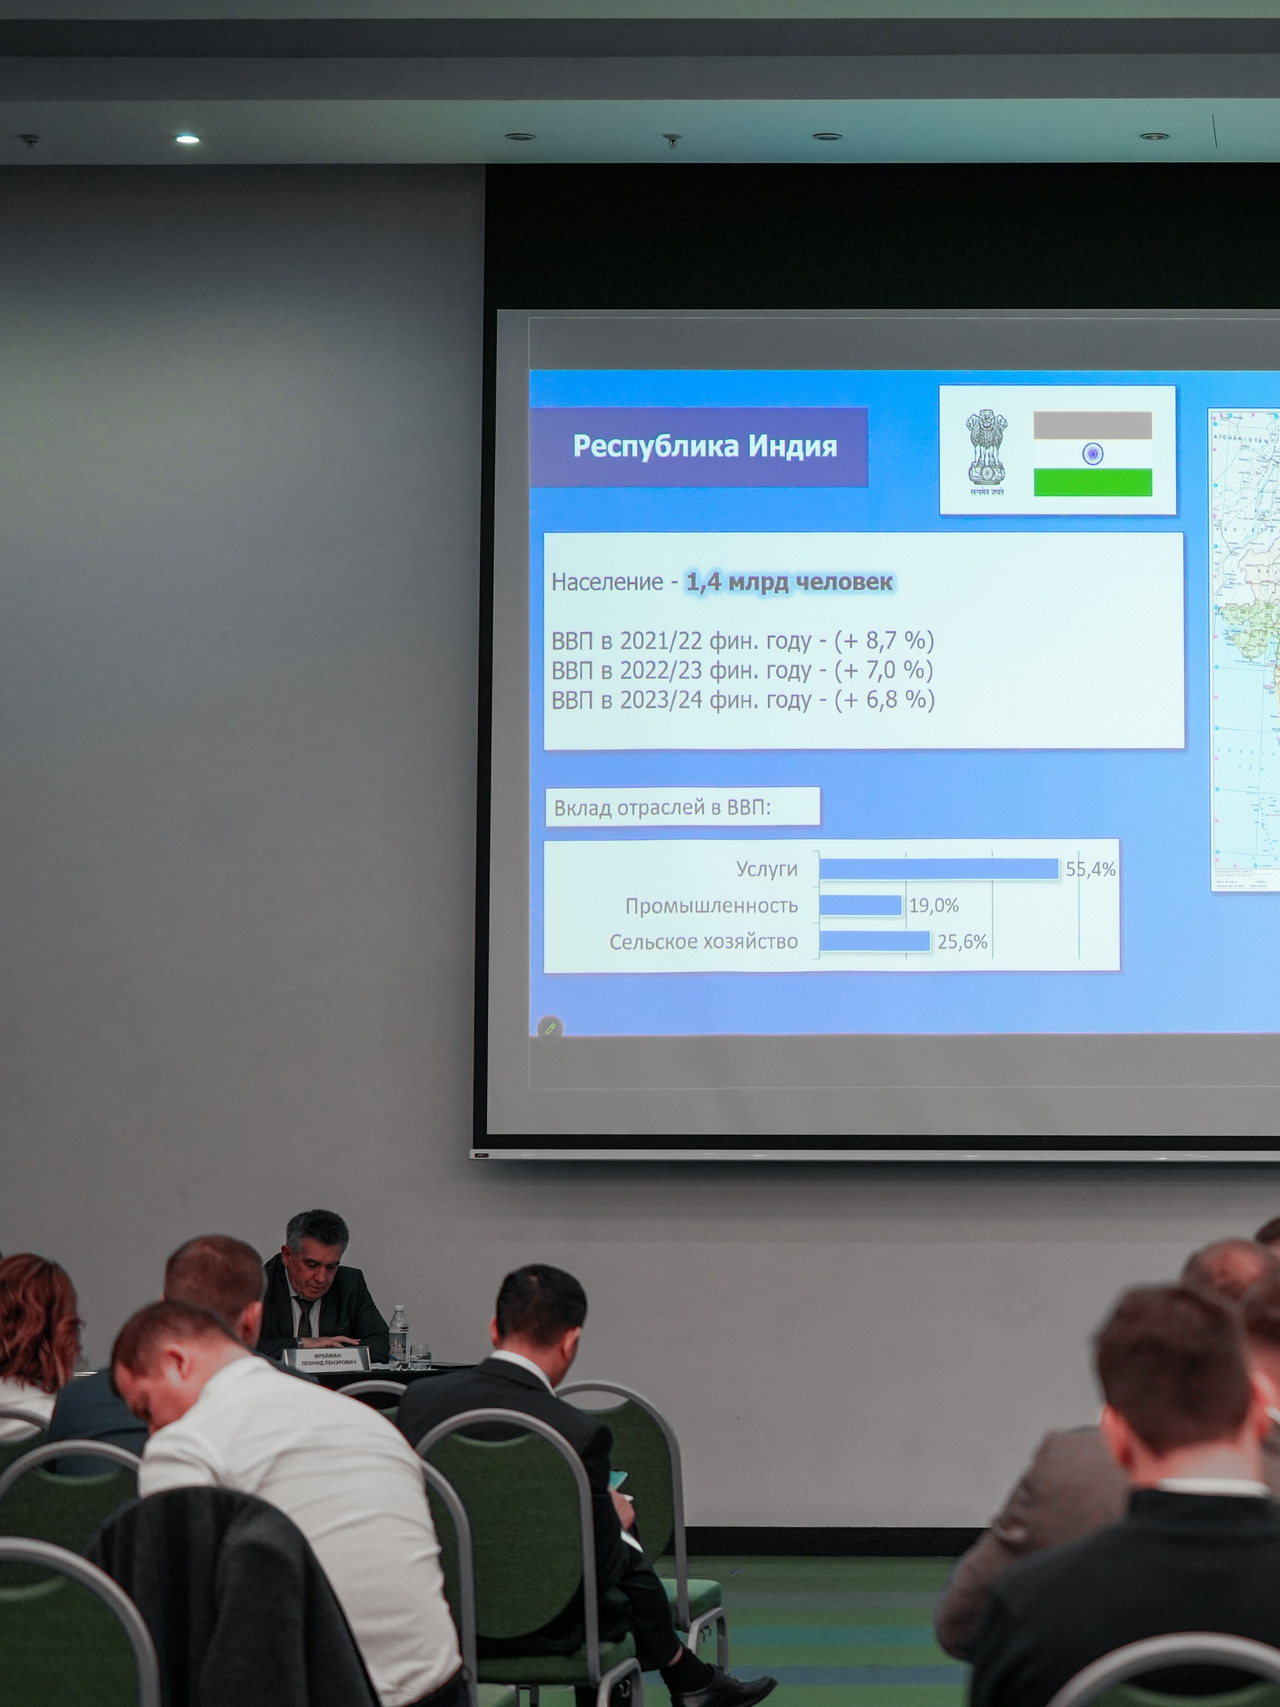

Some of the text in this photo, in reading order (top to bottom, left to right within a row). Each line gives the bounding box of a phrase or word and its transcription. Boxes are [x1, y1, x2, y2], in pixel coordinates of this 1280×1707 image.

[574, 433, 838, 463] Республика Индия
[552, 572, 664, 592] Население
[687, 571, 722, 596] 1,4
[729, 574, 790, 596] млрд
[796, 574, 894, 592] человек
[552, 631, 593, 651] ВВП
[601, 635, 613, 650] в
[620, 630, 703, 653] 2021/22
[709, 630, 758, 655] фин.
[767, 634, 813, 654] году
[834, 630, 859, 655] (+
[866, 630, 897, 654] 8,7
[904, 630, 934, 655] %)
[552, 660, 593, 680] ВВП
[601, 664, 613, 679] в
[620, 659, 703, 682] 2022/23
[709, 659, 758, 684] фин.
[767, 663, 813, 683] году
[834, 659, 859, 684] (+
[866, 659, 897, 683] 7,0
[904, 659, 934, 684] %)
[552, 690, 593, 710] ВВП
[601, 694, 613, 709] в
[620, 689, 703, 712] 2023/24
[709, 689, 758, 714] фин.
[767, 693, 813, 713] году
[834, 689, 859, 714] (+
[866, 689, 897, 713] 6,8
[904, 689, 934, 714] %)
[554, 797, 771, 820] Вклад отраслей в ВВП:
[736, 860, 1117, 881] Услуги 55,4%
[626, 896, 960, 919] Промышленность 19,0%
[609, 931, 988, 952] Сельское хозяйство 25,6%
